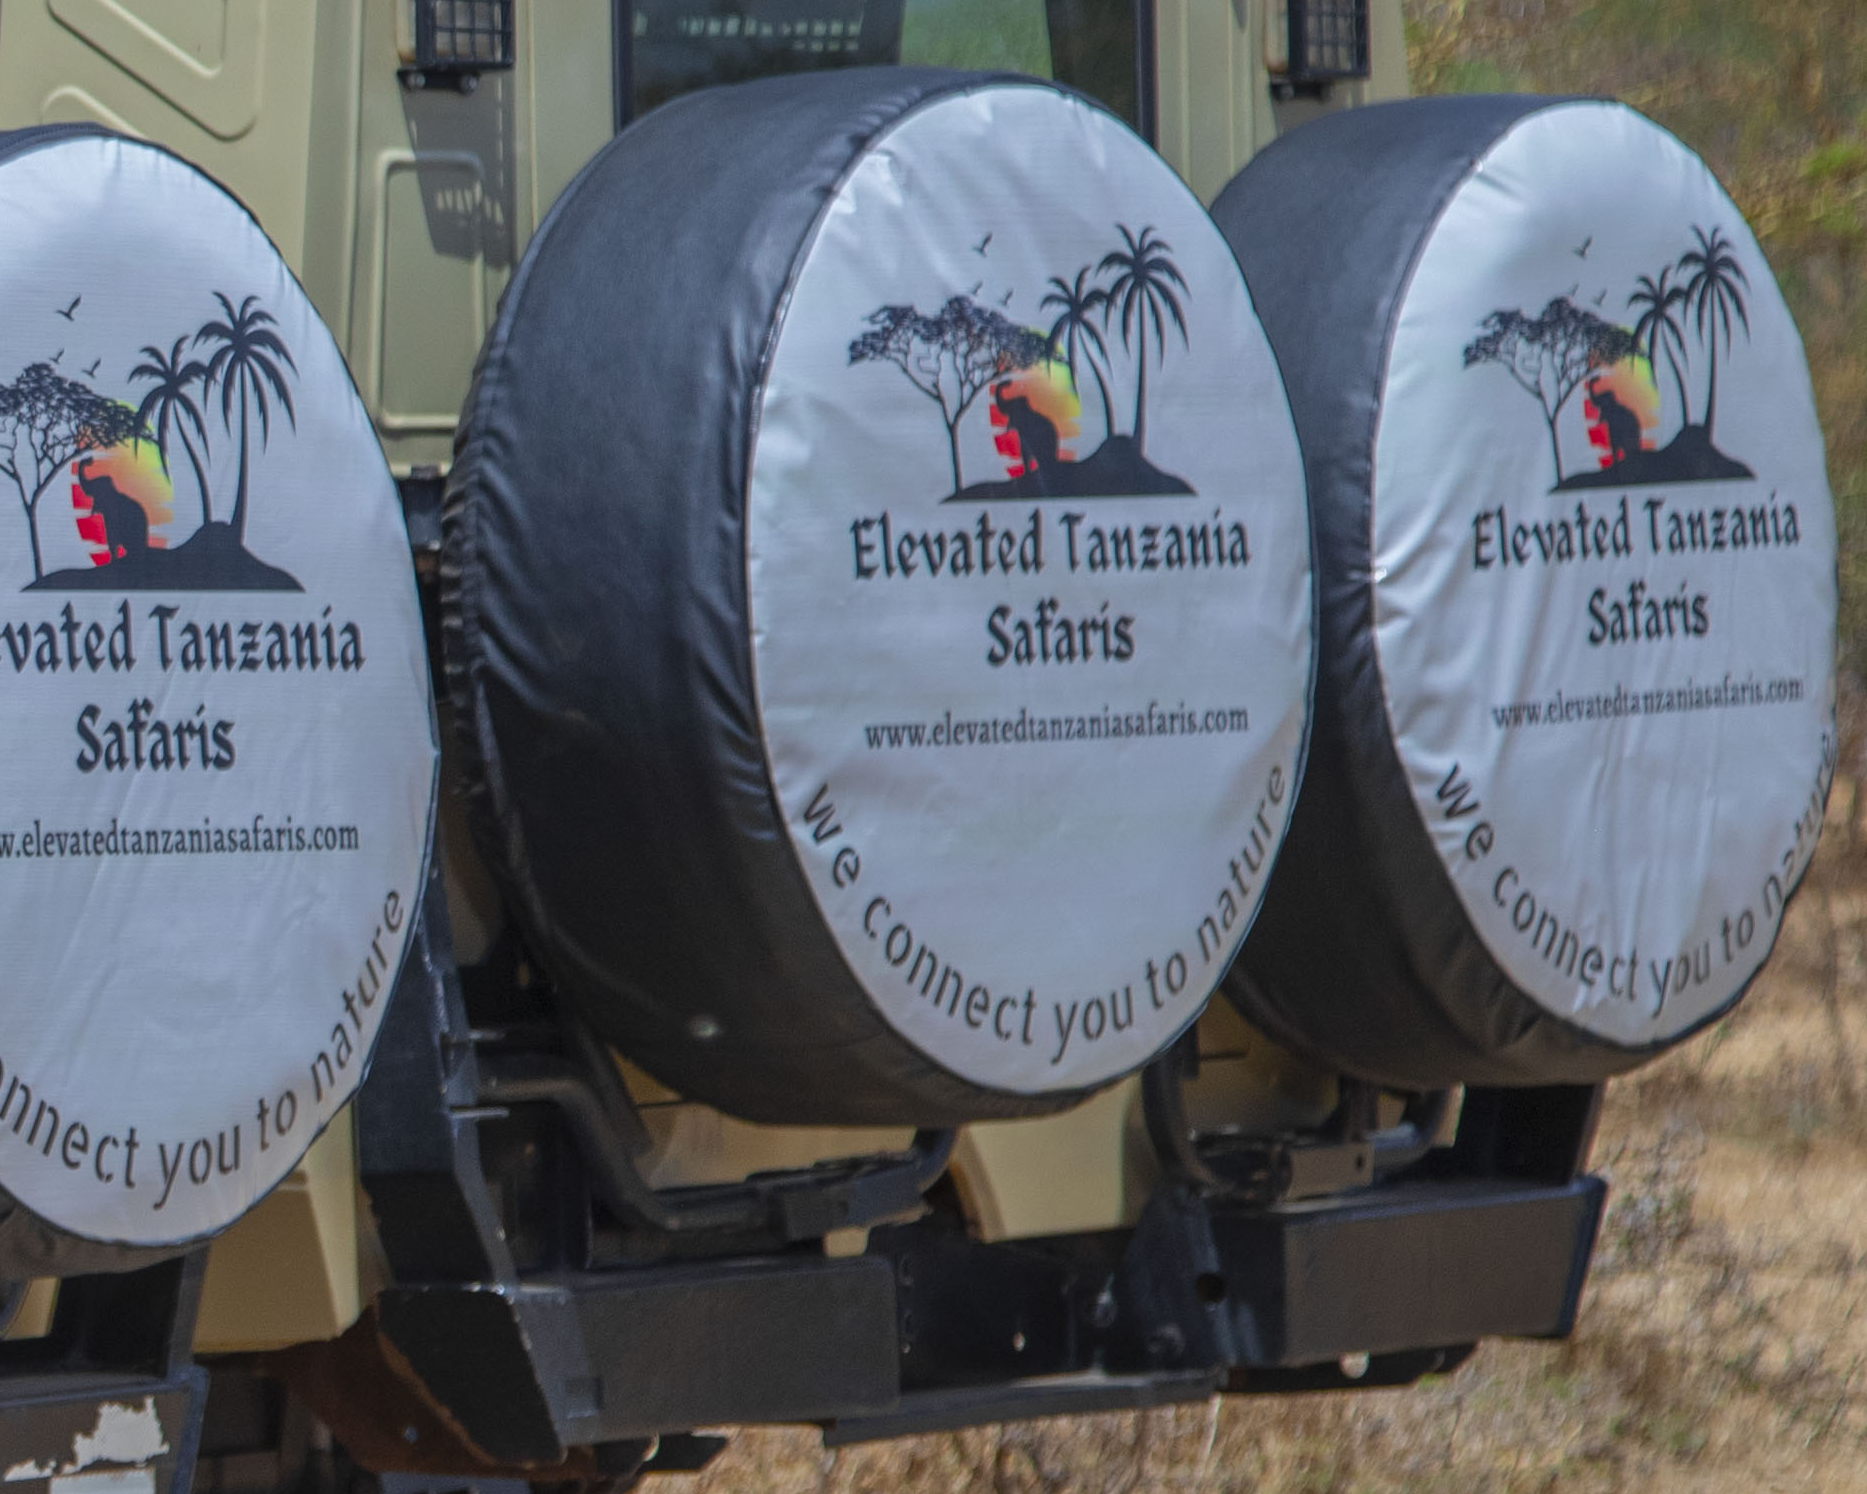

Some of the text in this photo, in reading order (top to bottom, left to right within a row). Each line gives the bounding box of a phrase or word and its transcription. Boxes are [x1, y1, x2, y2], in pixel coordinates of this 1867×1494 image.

[851, 507, 1044, 580] Elevated
[1473, 496, 1633, 569] Elevated
[865, 702, 1250, 749] www.elevatedtanzaniasafaris.com
[1492, 673, 1804, 730] www.elevatedtanzaniasafaris.com
[803, 764, 1284, 1065] We connect you to nature
[1436, 764, 1494, 862] We
[1494, 866, 1638, 1001] connect
[1650, 943, 1711, 1017] you
[1722, 908, 1754, 964] to
[153, 1124, 241, 1209] you
[256, 1090, 297, 1153] to
[310, 889, 404, 1102] nature
